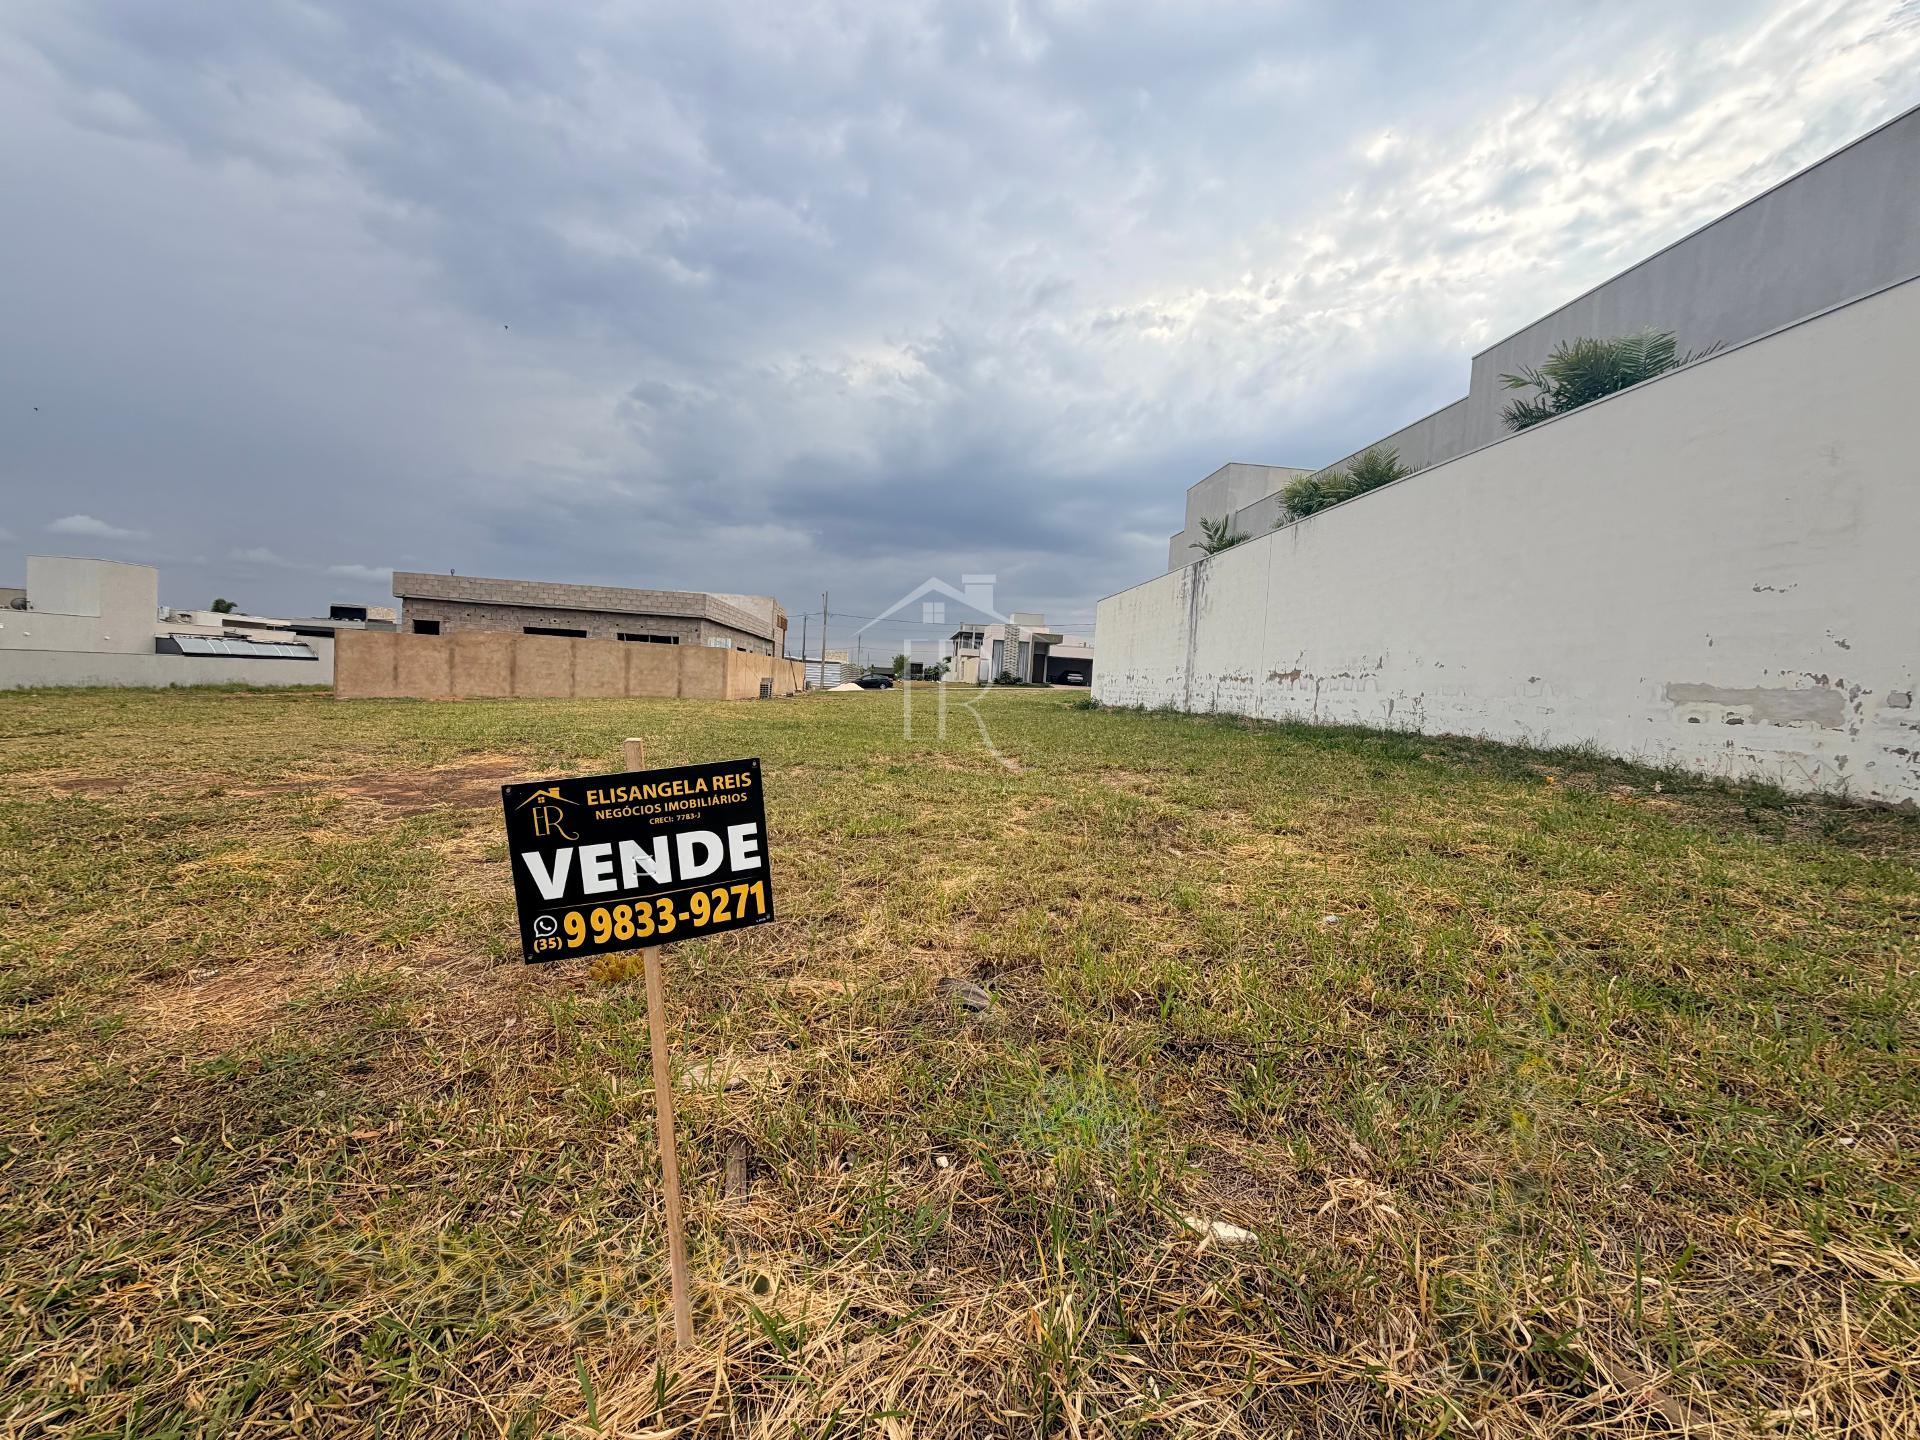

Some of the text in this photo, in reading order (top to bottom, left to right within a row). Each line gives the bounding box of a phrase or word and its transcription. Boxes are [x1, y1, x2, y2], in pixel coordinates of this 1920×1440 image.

[586, 771, 752, 806] ELISANGELA REIS
[595, 792, 748, 821] NEGÓCIOS IMOBILIÁRIOS
[649, 815, 674, 825] CRECI:
[521, 822, 762, 900] VENDE
[533, 936, 563, 953] (35)
